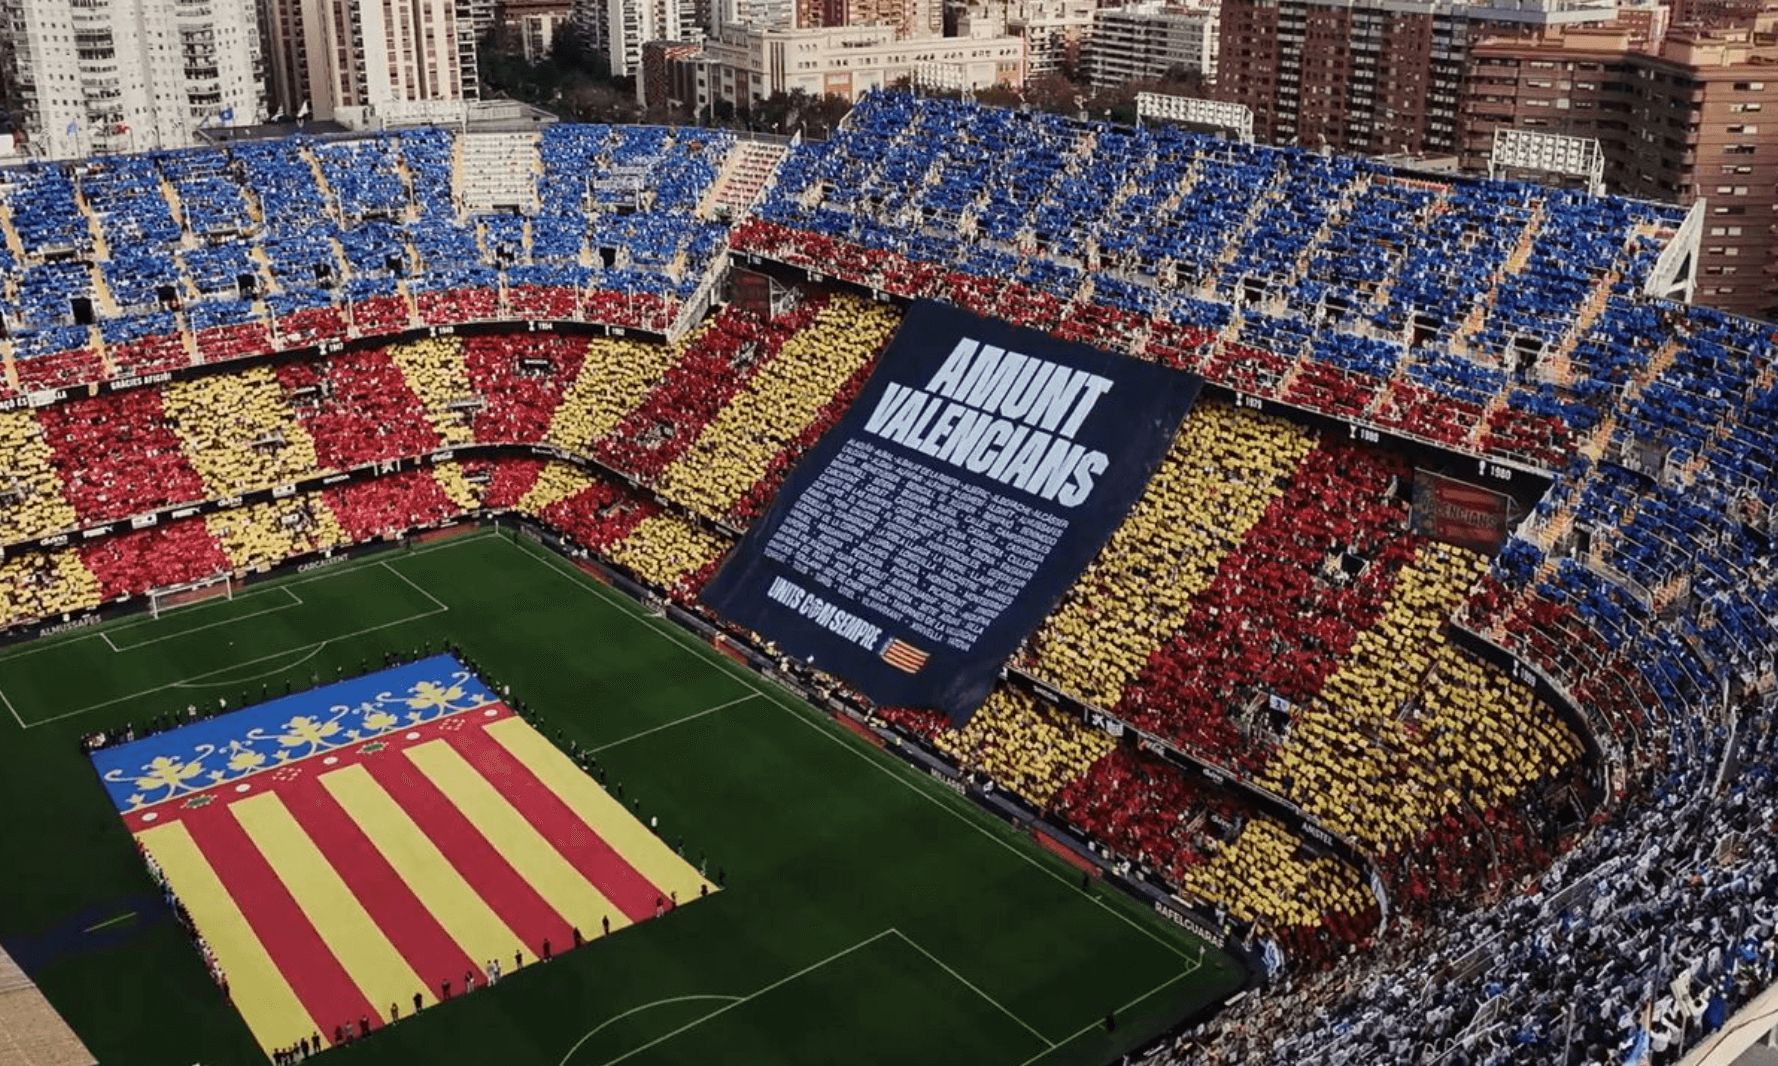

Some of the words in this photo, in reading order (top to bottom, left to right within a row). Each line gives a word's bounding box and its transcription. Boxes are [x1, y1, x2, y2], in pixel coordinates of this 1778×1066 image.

[925, 337, 1115, 439] AMUNT
[863, 382, 1110, 508] VALENCIANS
[767, 576, 806, 609] UNITS
[829, 610, 882, 651] SEMPRE
[1301, 821, 1333, 846] AMSTEL
